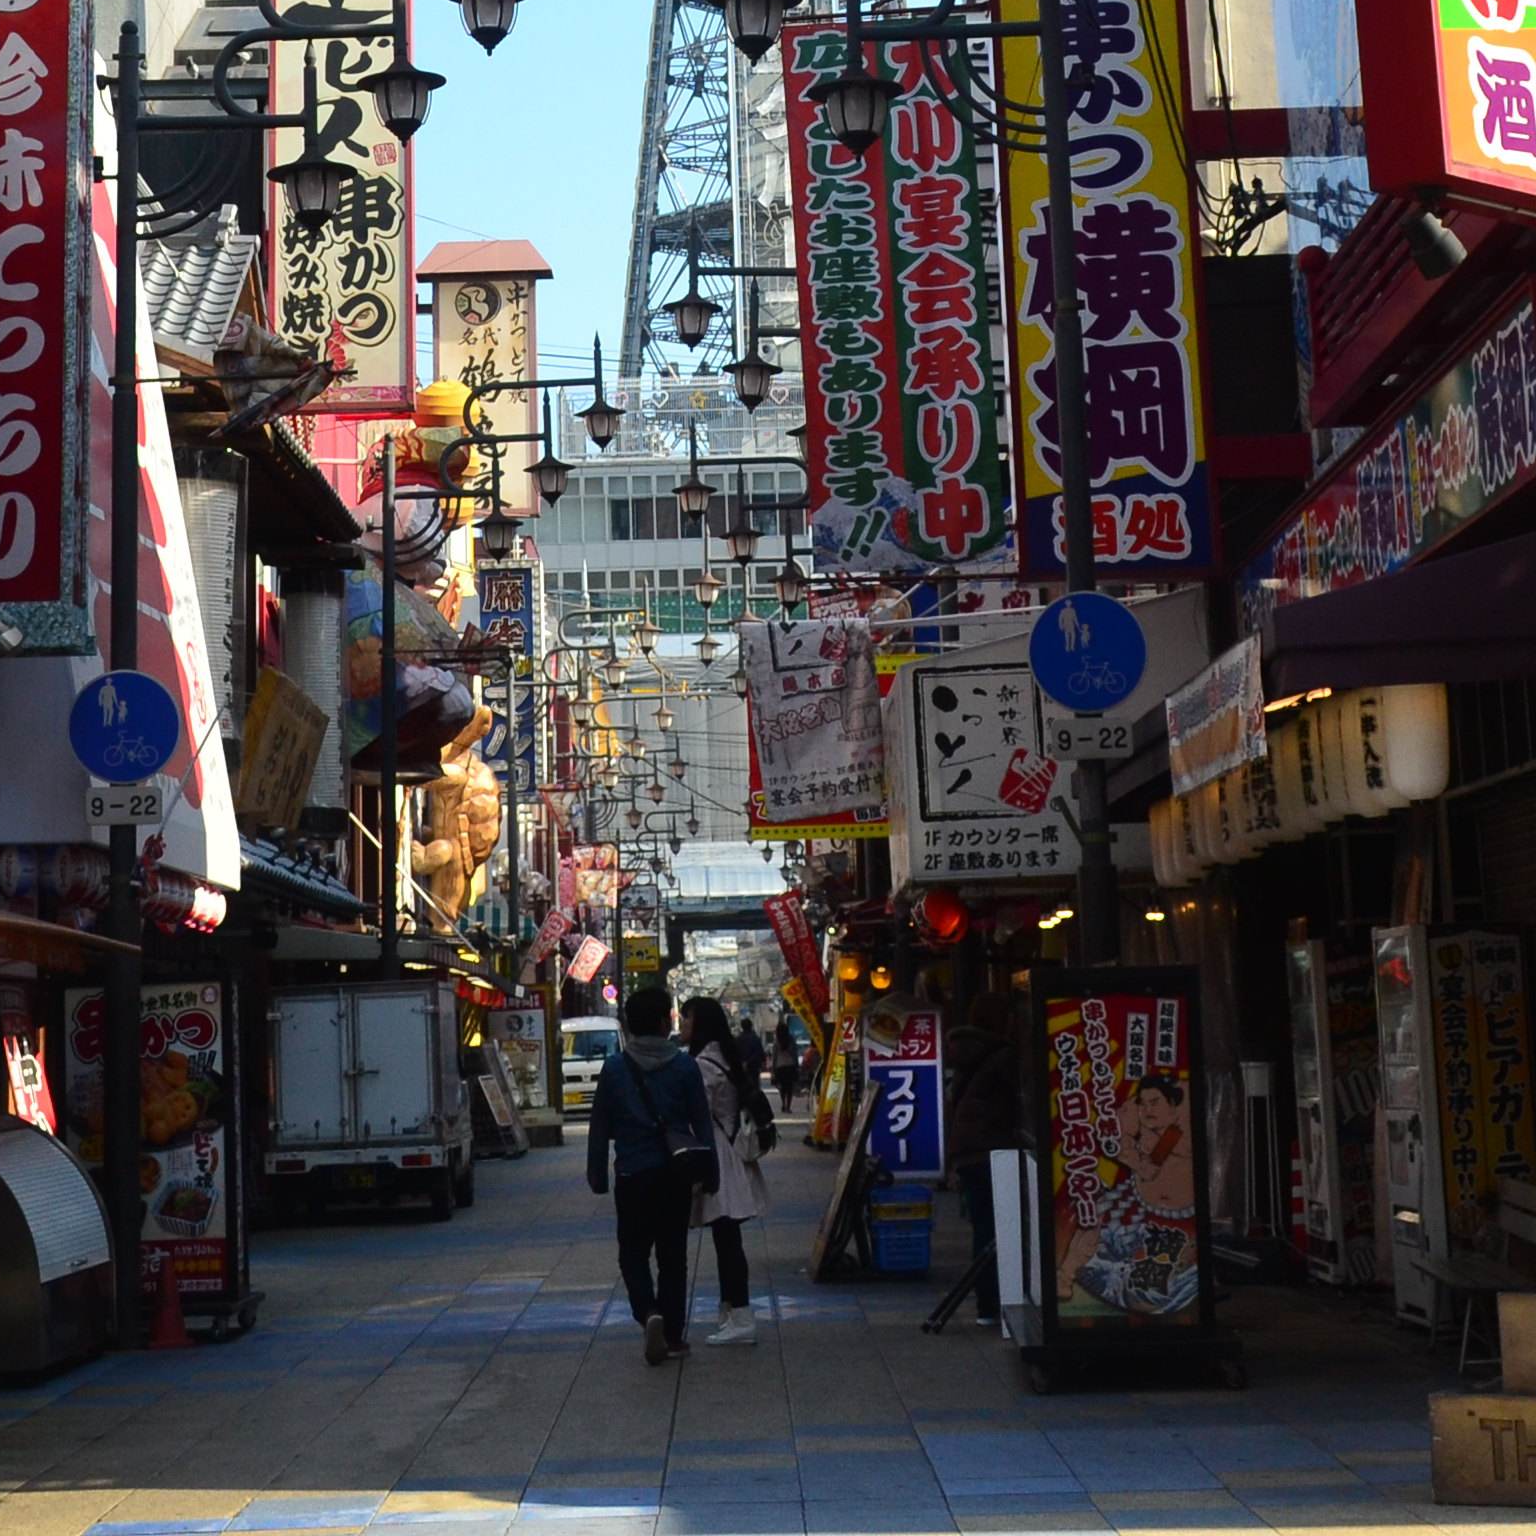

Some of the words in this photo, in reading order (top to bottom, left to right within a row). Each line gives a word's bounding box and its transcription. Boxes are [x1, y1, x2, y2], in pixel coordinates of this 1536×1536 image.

[335, 171, 405, 346] 串かつ
[889, 37, 988, 558] 大小宴会承り中
[924, 830, 942, 847] 1F
[947, 825, 1061, 847] カウンター席
[924, 852, 943, 871] 2F
[947, 849, 1061, 871] 座敷あります
[886, 1070, 917, 1163] スター
[1081, 999, 1121, 1157] 串かつもどて焼も
